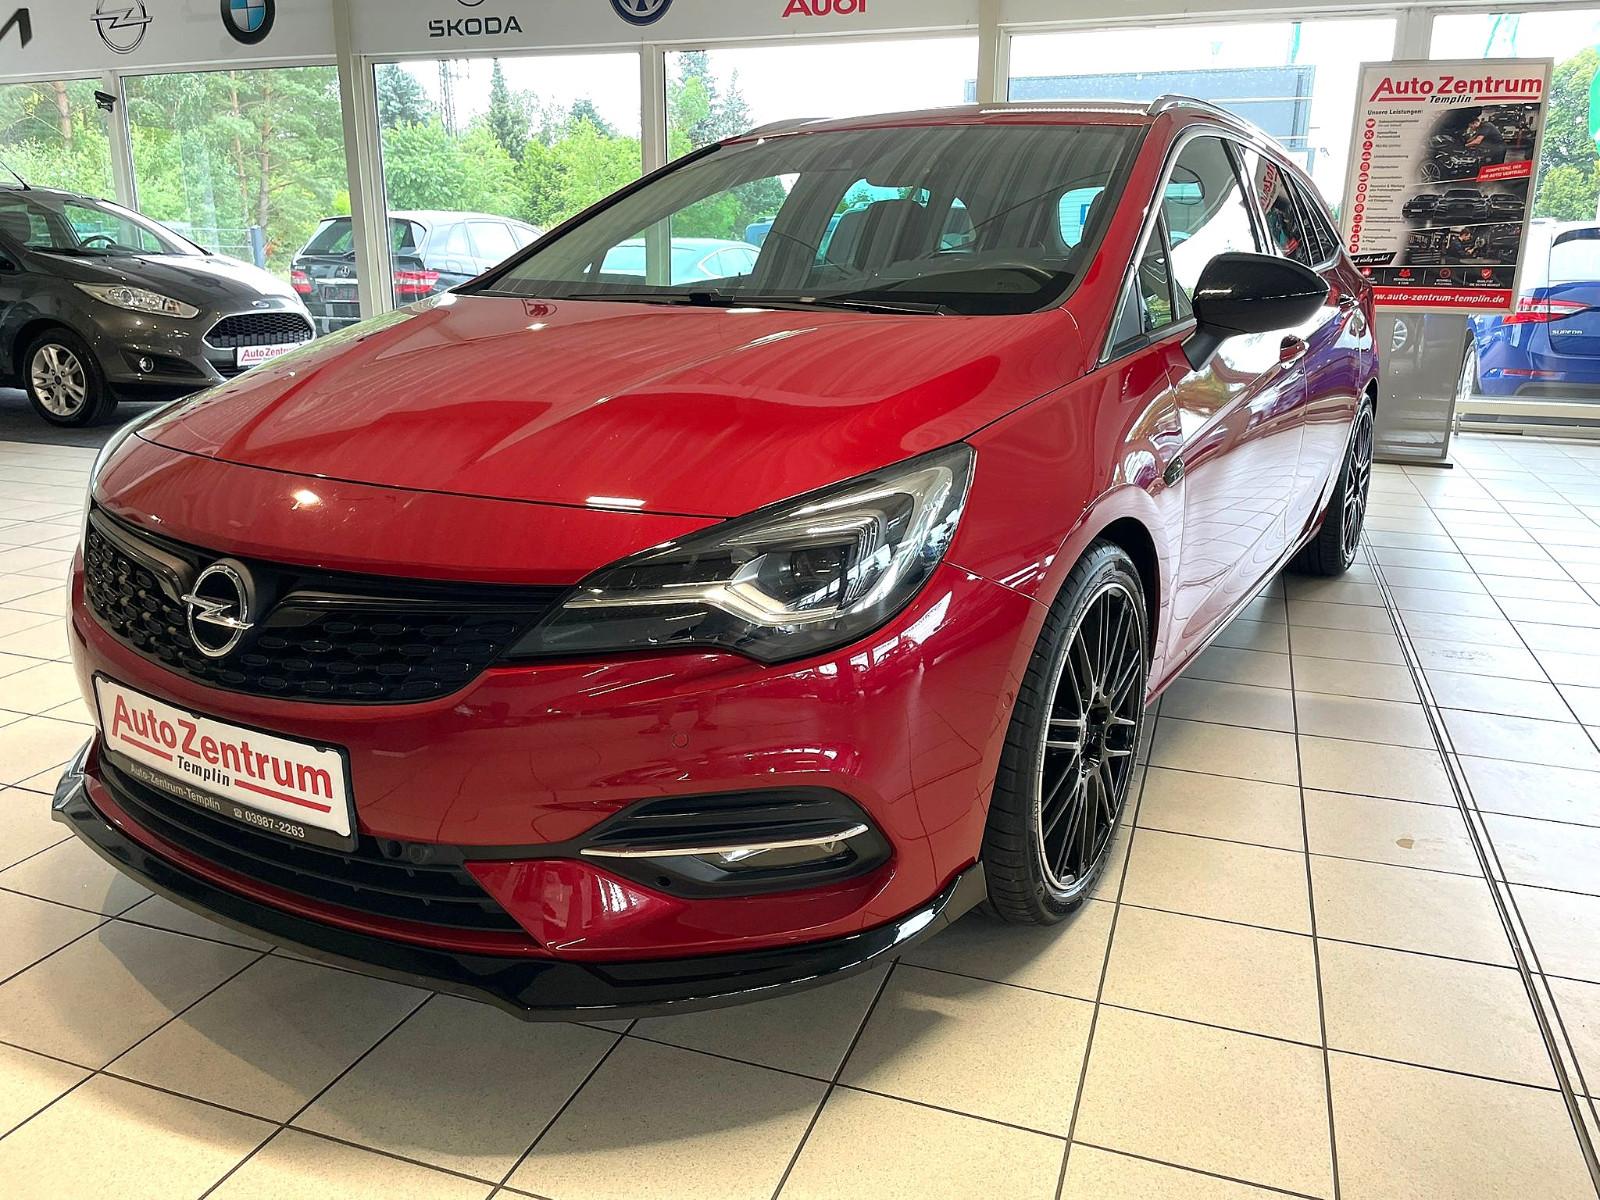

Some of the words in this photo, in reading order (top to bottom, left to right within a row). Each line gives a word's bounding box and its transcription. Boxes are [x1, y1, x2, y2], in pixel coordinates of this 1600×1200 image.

[428, 15, 523, 38] SKODA
[1429, 95, 1472, 104] Templin
[176, 755, 231, 787] Templin
[129, 763, 222, 811] Auto-Zentrum-Templin
[244, 810, 306, 838] 03987-2263
